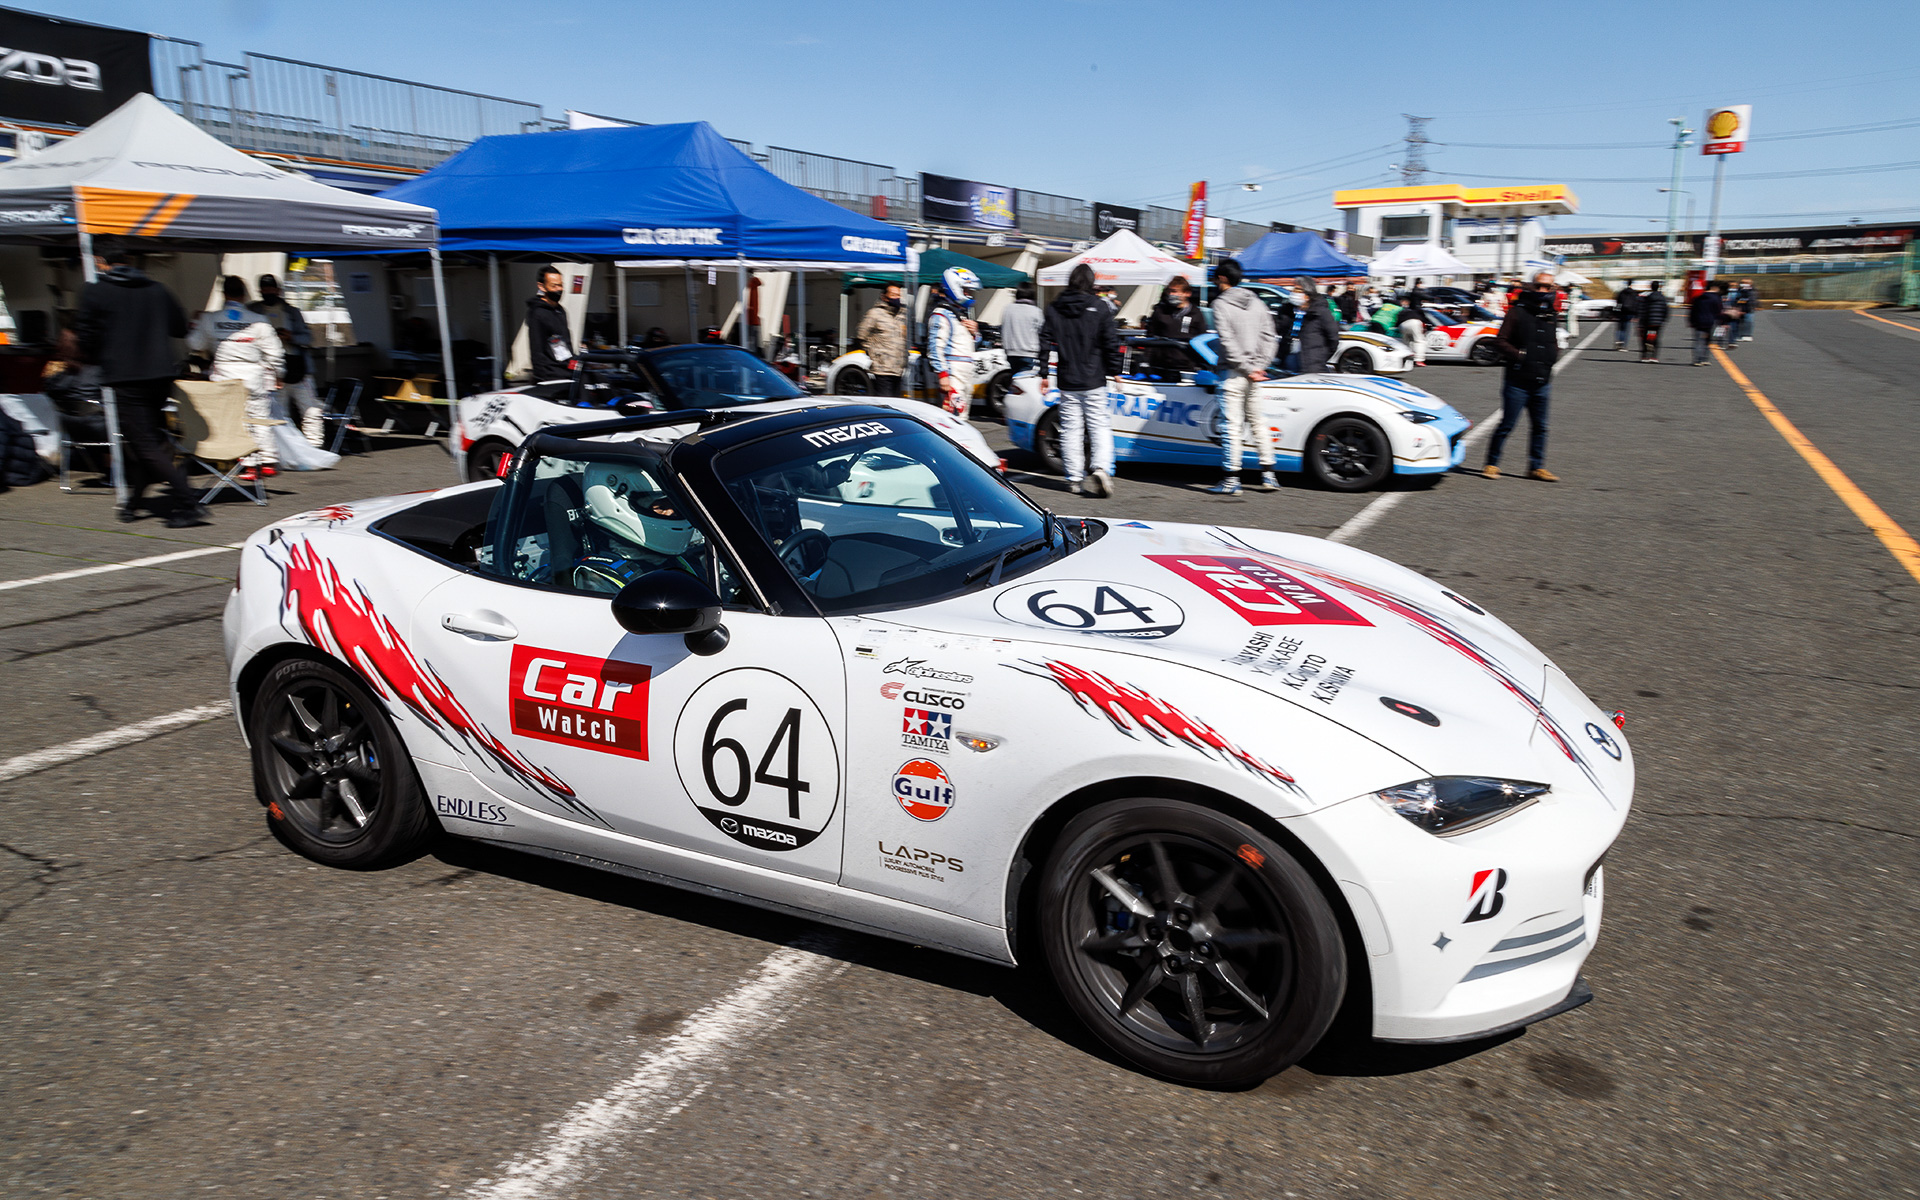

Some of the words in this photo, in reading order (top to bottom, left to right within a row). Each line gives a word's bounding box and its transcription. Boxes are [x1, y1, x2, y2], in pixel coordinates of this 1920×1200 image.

[1501, 190, 1552, 202] Shell
[1027, 586, 1155, 628] 64
[523, 657, 634, 712] Car
[537, 706, 617, 744] Watch
[702, 698, 811, 820] 64
[901, 734, 950, 751] TAMIYA
[895, 777, 953, 805] Gulf
[437, 794, 508, 822] ENDLESS
[878, 840, 964, 873] LAPPS
